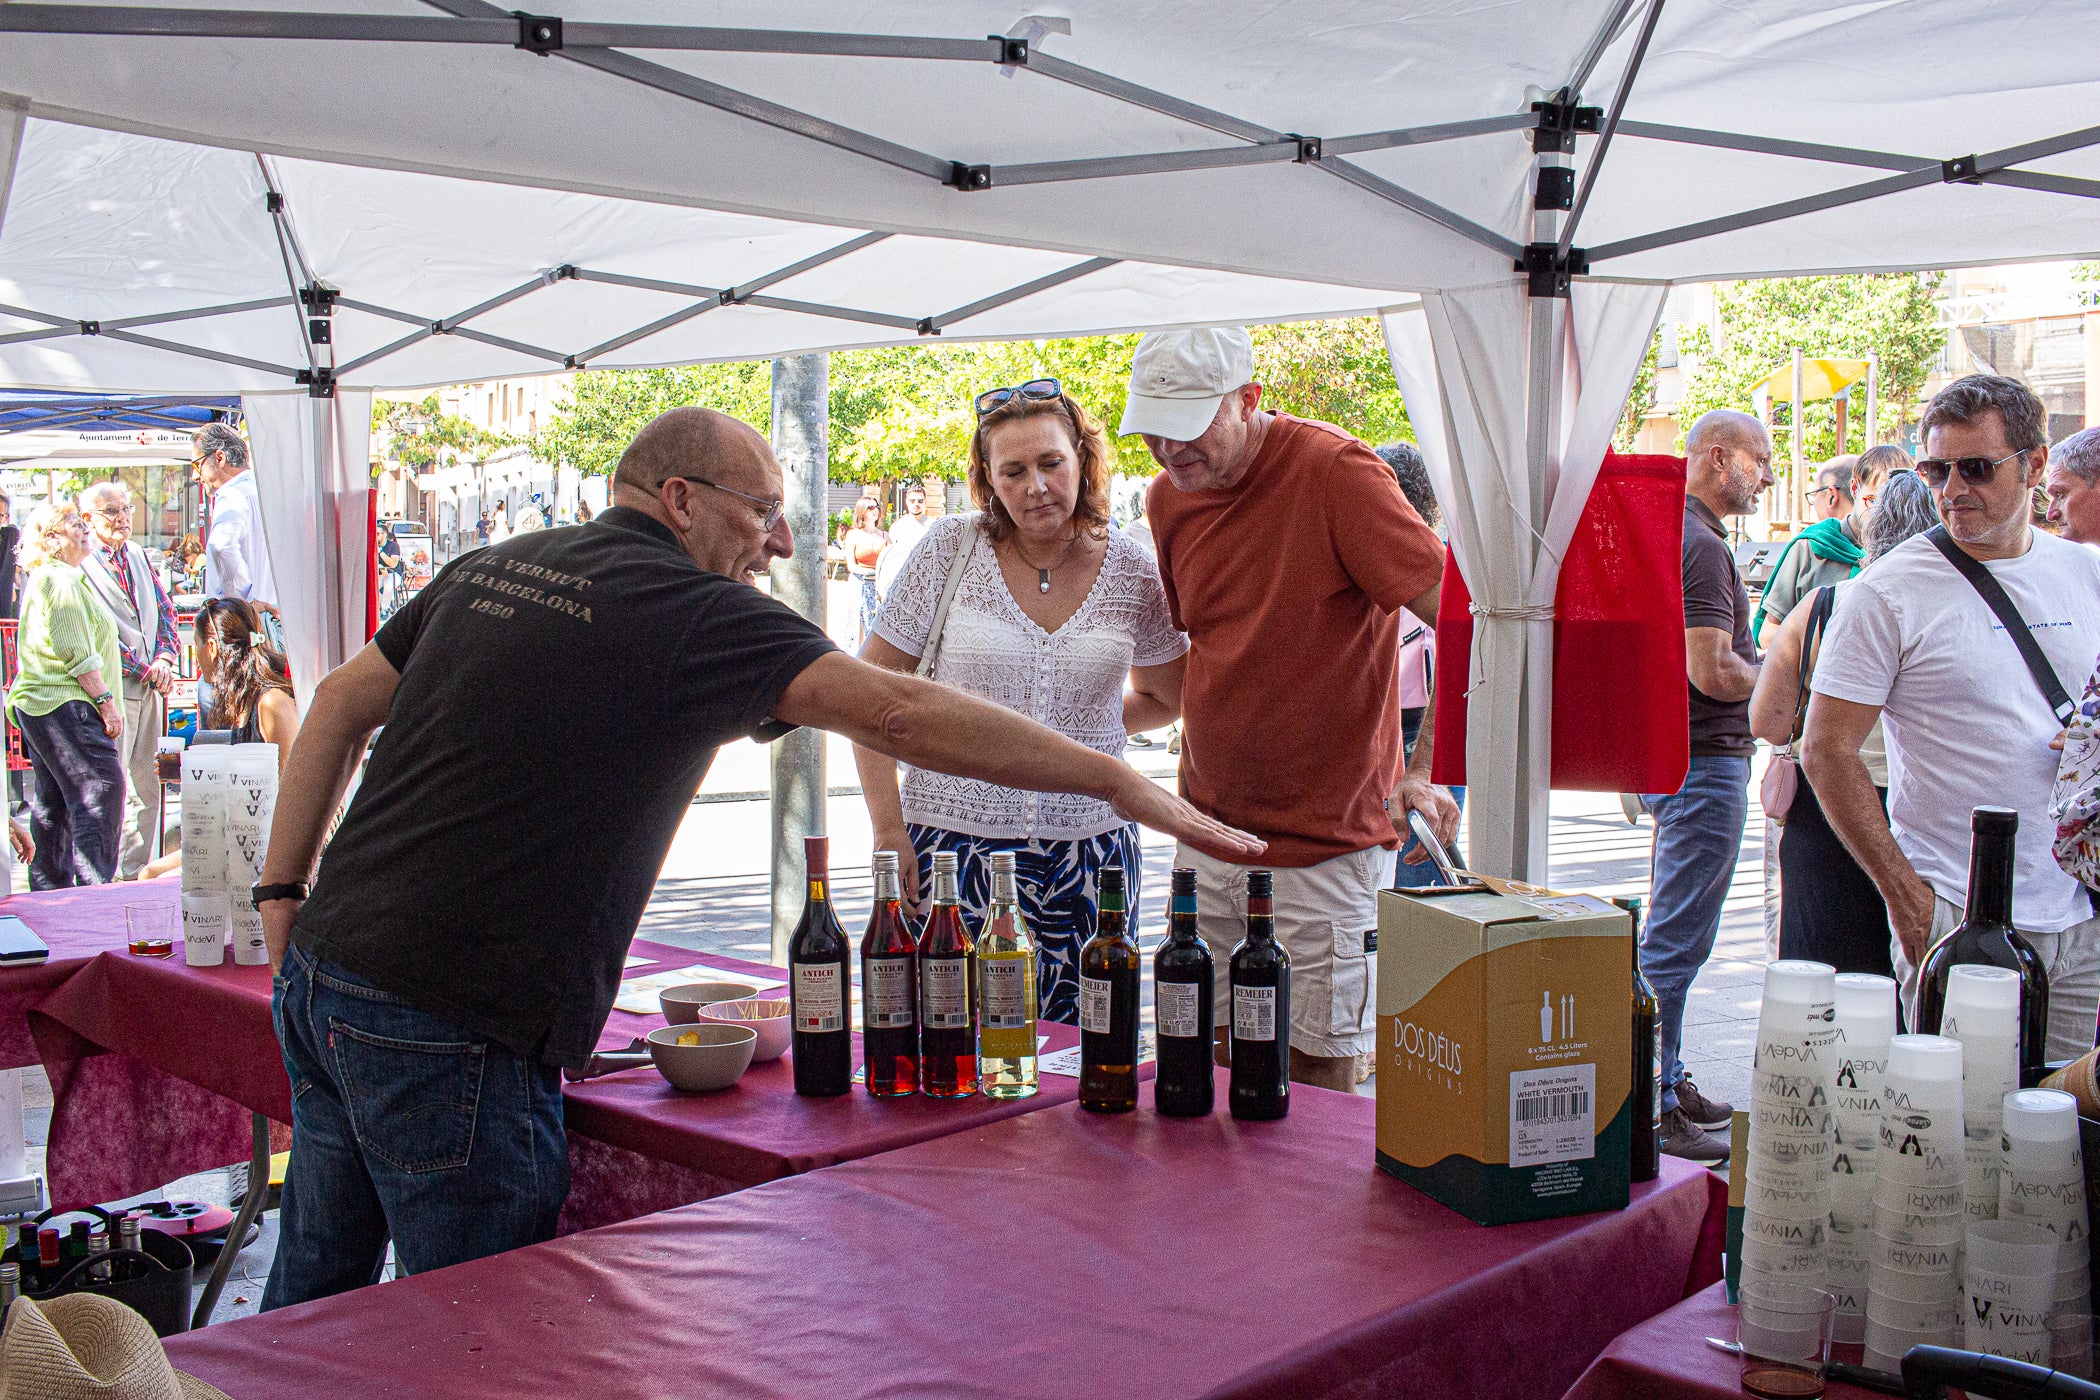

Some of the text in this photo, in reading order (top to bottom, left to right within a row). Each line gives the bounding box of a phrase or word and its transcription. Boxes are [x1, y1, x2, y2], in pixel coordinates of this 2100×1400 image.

[79, 433, 132, 443] Ajuntament
[157, 434, 169, 442] de
[505, 559, 593, 592] VERMUT
[470, 571, 593, 623] BARCELONA
[469, 598, 516, 619] 1850
[191, 914, 223, 924] VINARI
[802, 969, 834, 977] ANTICH
[1235, 987, 1273, 999] REMEIER
[1394, 1017, 1462, 1075] DOS DÉUS
[1763, 1042, 1818, 1061] VAdeVi
[1535, 1053, 1563, 1061] Contains
[1395, 1053, 1462, 1095] ORIGINS
[1555, 1077, 1578, 1085] Origins
[1517, 1085, 1584, 1099] WHITE VERMOUTH
